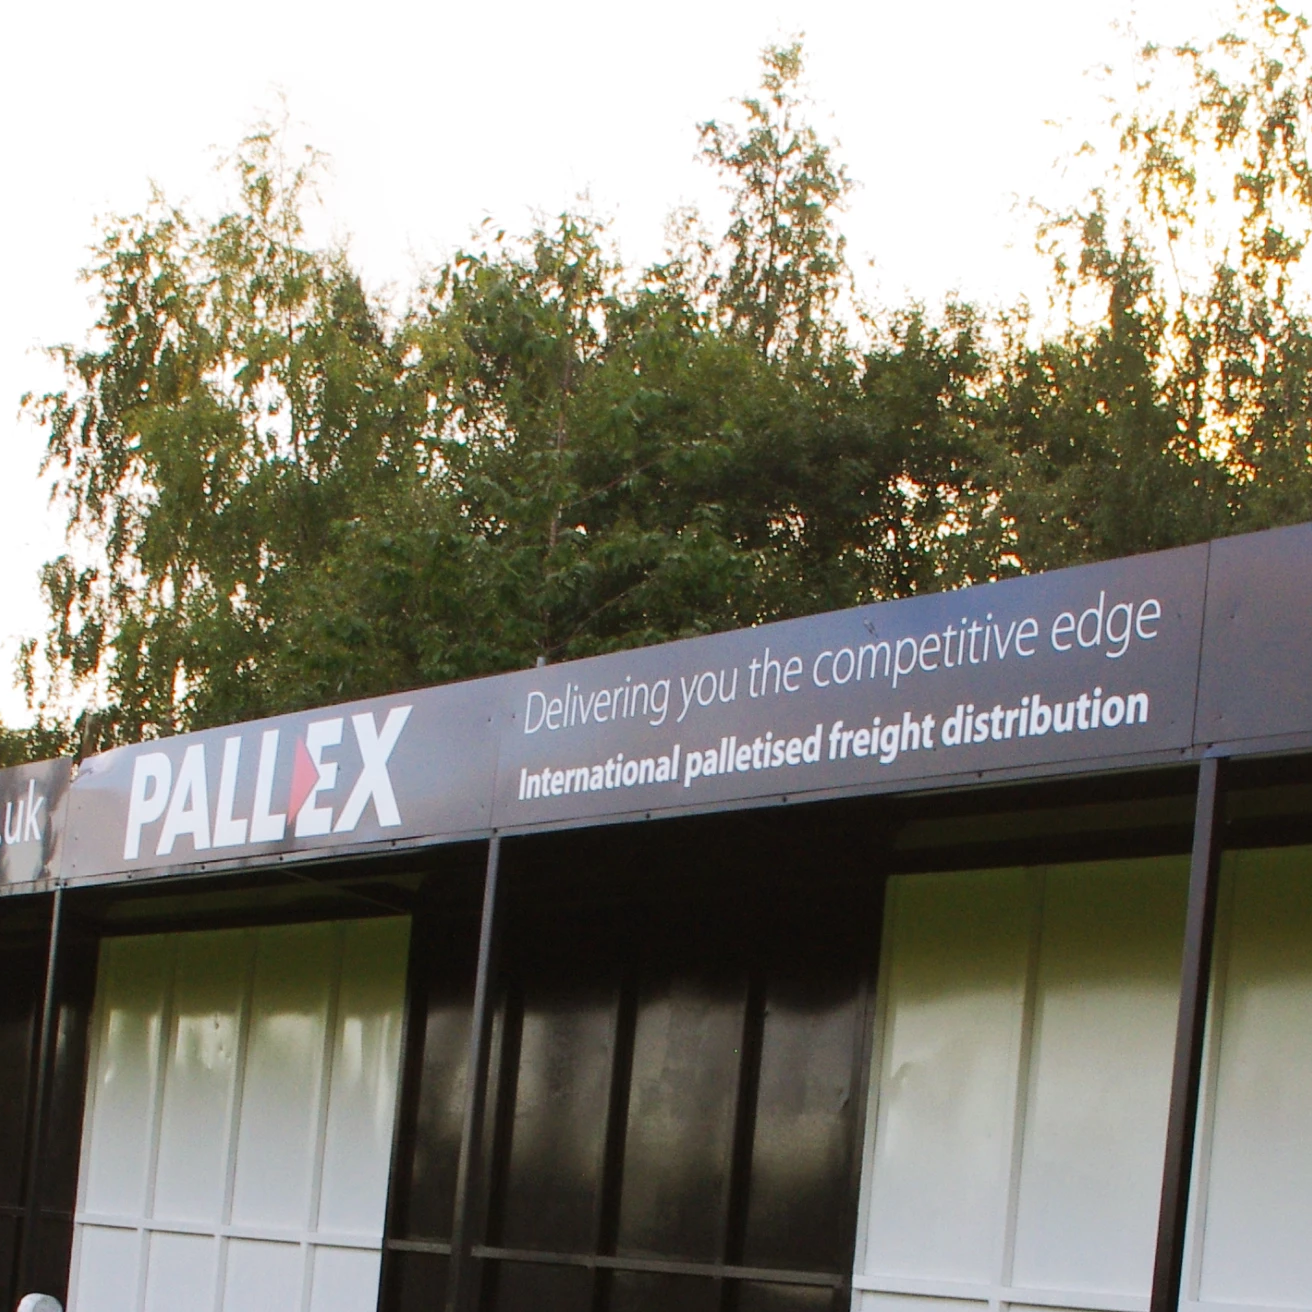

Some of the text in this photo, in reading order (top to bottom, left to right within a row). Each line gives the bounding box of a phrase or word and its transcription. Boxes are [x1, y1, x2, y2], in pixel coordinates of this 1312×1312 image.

[524, 591, 1161, 734] Delivering you the competitive edge
[123, 705, 413, 860] PALLEX
[518, 686, 1149, 800] International palletised freight distribution
